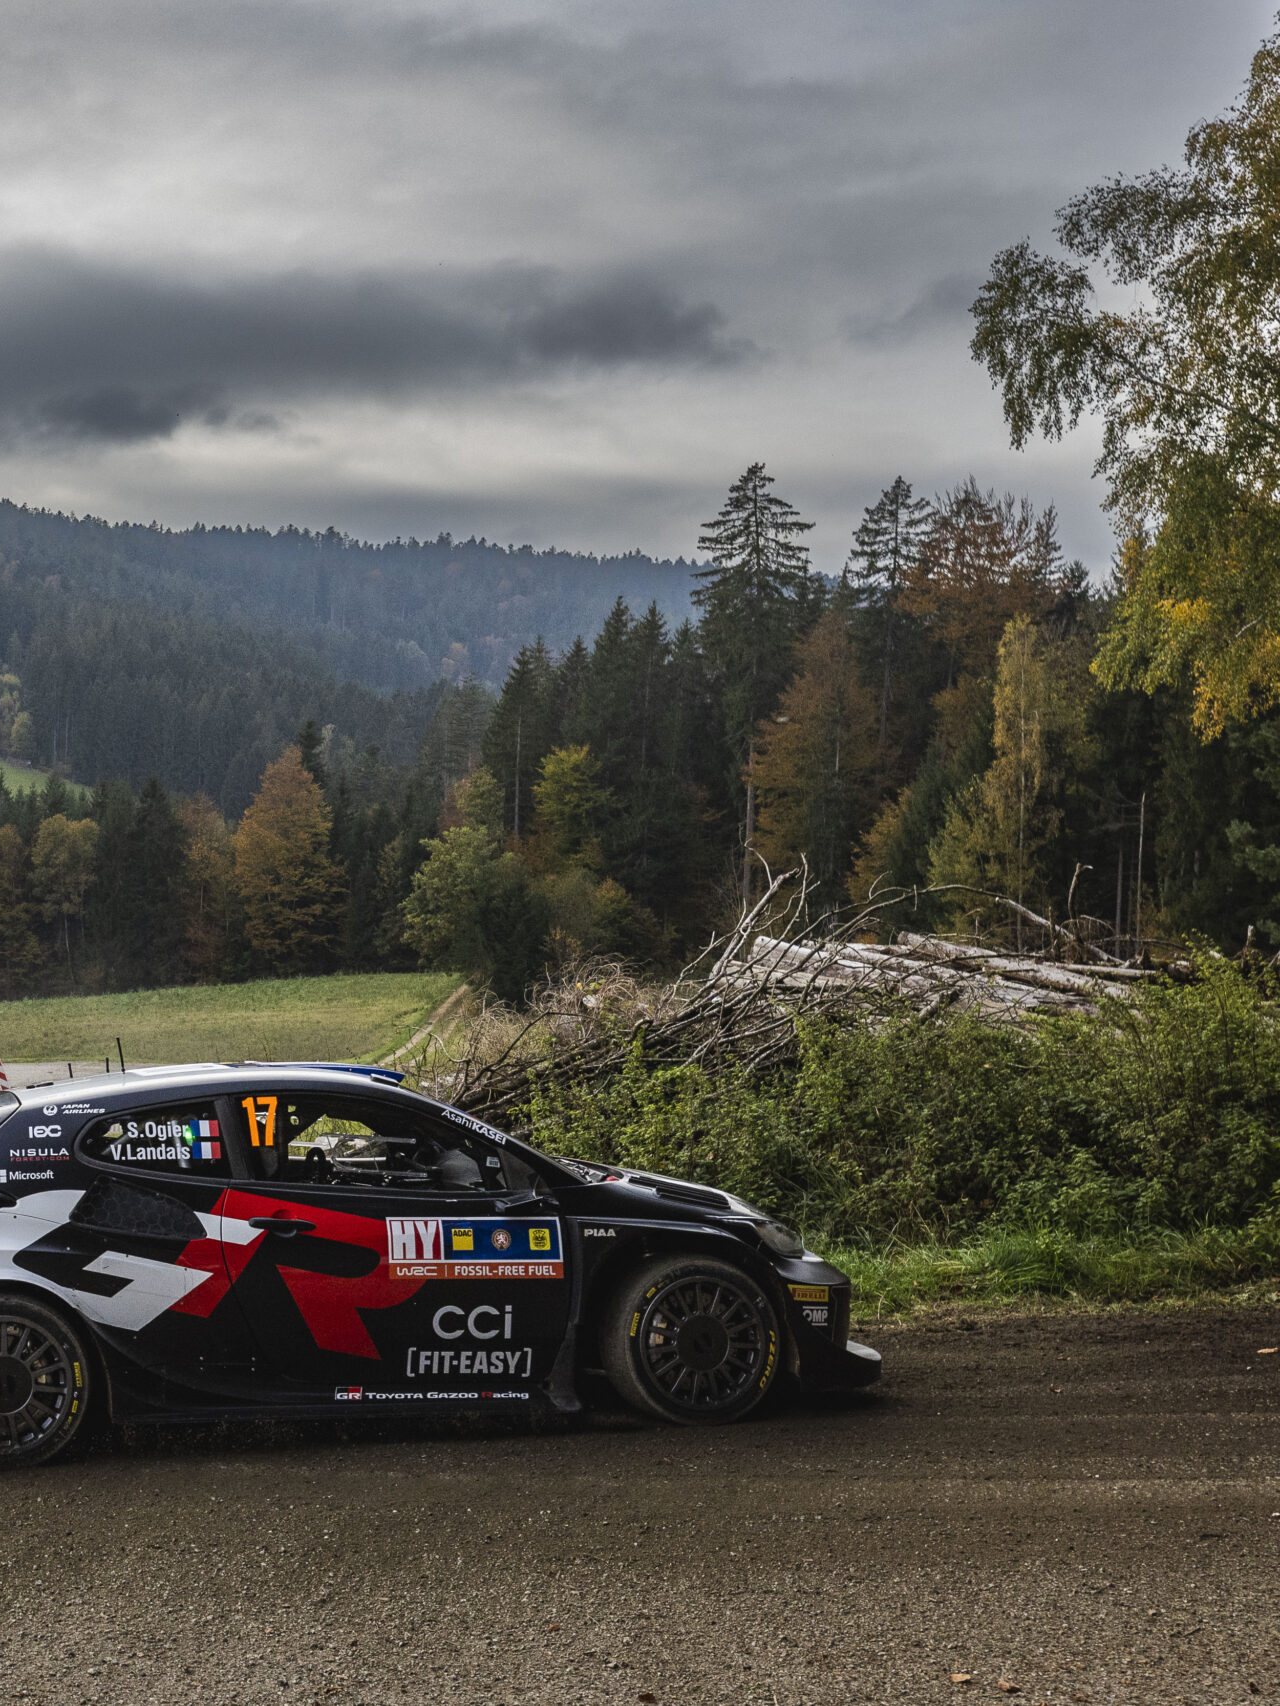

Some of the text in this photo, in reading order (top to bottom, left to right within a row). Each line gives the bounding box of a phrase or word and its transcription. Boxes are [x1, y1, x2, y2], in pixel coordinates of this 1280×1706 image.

[241, 1096, 278, 1147] 17
[127, 1121, 188, 1141] S.Ogier
[10, 1147, 69, 1156] NISULA
[110, 1144, 191, 1160] V.Landais
[9, 1170, 54, 1180] Microsoft
[584, 1228, 616, 1237] PIAA
[391, 1220, 438, 1259] HY
[396, 1266, 438, 1276] WRC
[454, 1265, 556, 1276] FOSSIL-FREE FUEL
